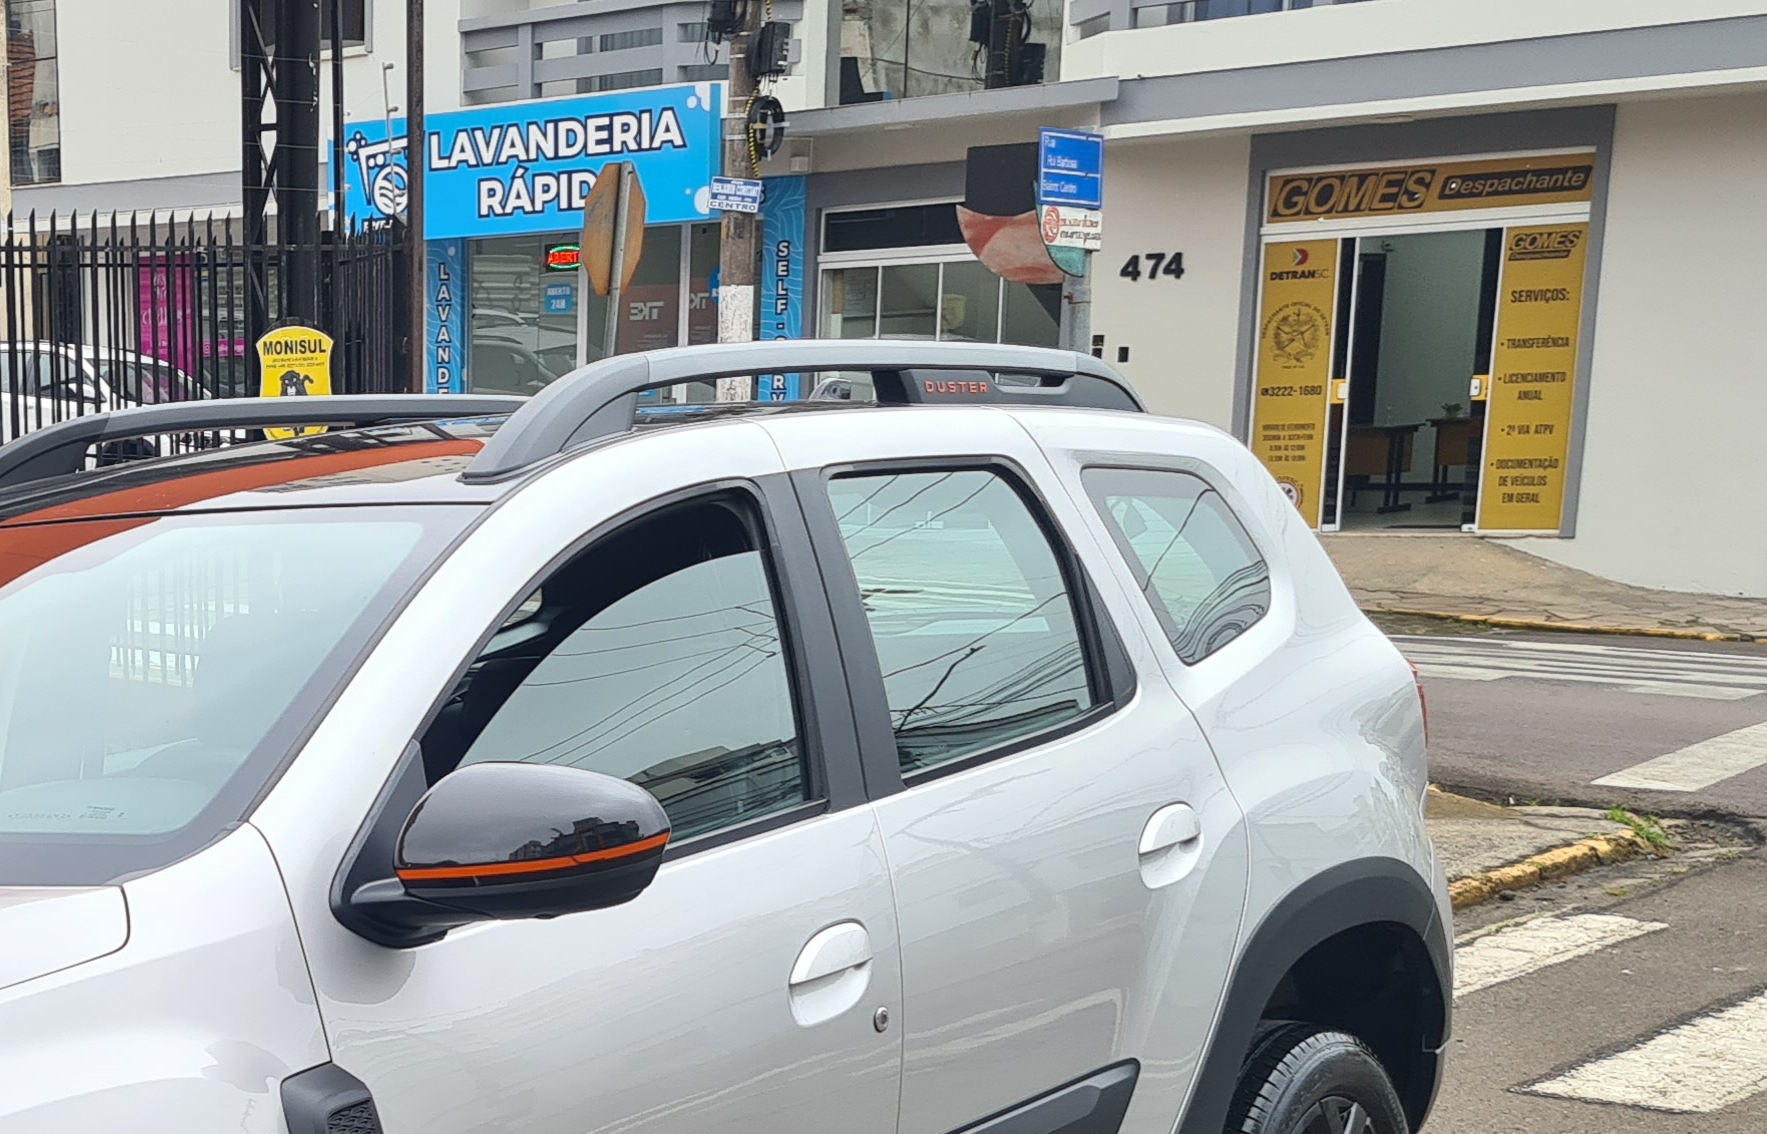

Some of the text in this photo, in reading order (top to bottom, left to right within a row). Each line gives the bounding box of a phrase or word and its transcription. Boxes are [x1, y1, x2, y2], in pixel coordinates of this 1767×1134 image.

[428, 106, 687, 171] LAVANDERIA
[478, 166, 598, 218] RÁPID
[1271, 168, 1585, 217] GOMES Despachante
[710, 200, 756, 211] CENTRO
[1509, 230, 1582, 250] GOMES
[547, 251, 580, 264] ABERT
[1119, 251, 1185, 281] 474
[1510, 288, 1570, 303] SERVIÇOS:
[263, 339, 326, 356] MONISUL
[1506, 335, 1570, 349] TRANSFERÊNCIA
[1503, 372, 1567, 384] LICENCIAMENTO
[925, 380, 989, 393] DUSTER
[1269, 385, 1322, 397] 3222-1680
[1517, 390, 1543, 401] ANUAL
[1517, 424, 1530, 435] VIA
[1533, 424, 1554, 435] ATPV
[1495, 456, 1559, 470] DOCUMENTAÇÃO
[1498, 474, 1547, 487] DE VEÍCULOS
[1501, 493, 1540, 504] EM GERAL
